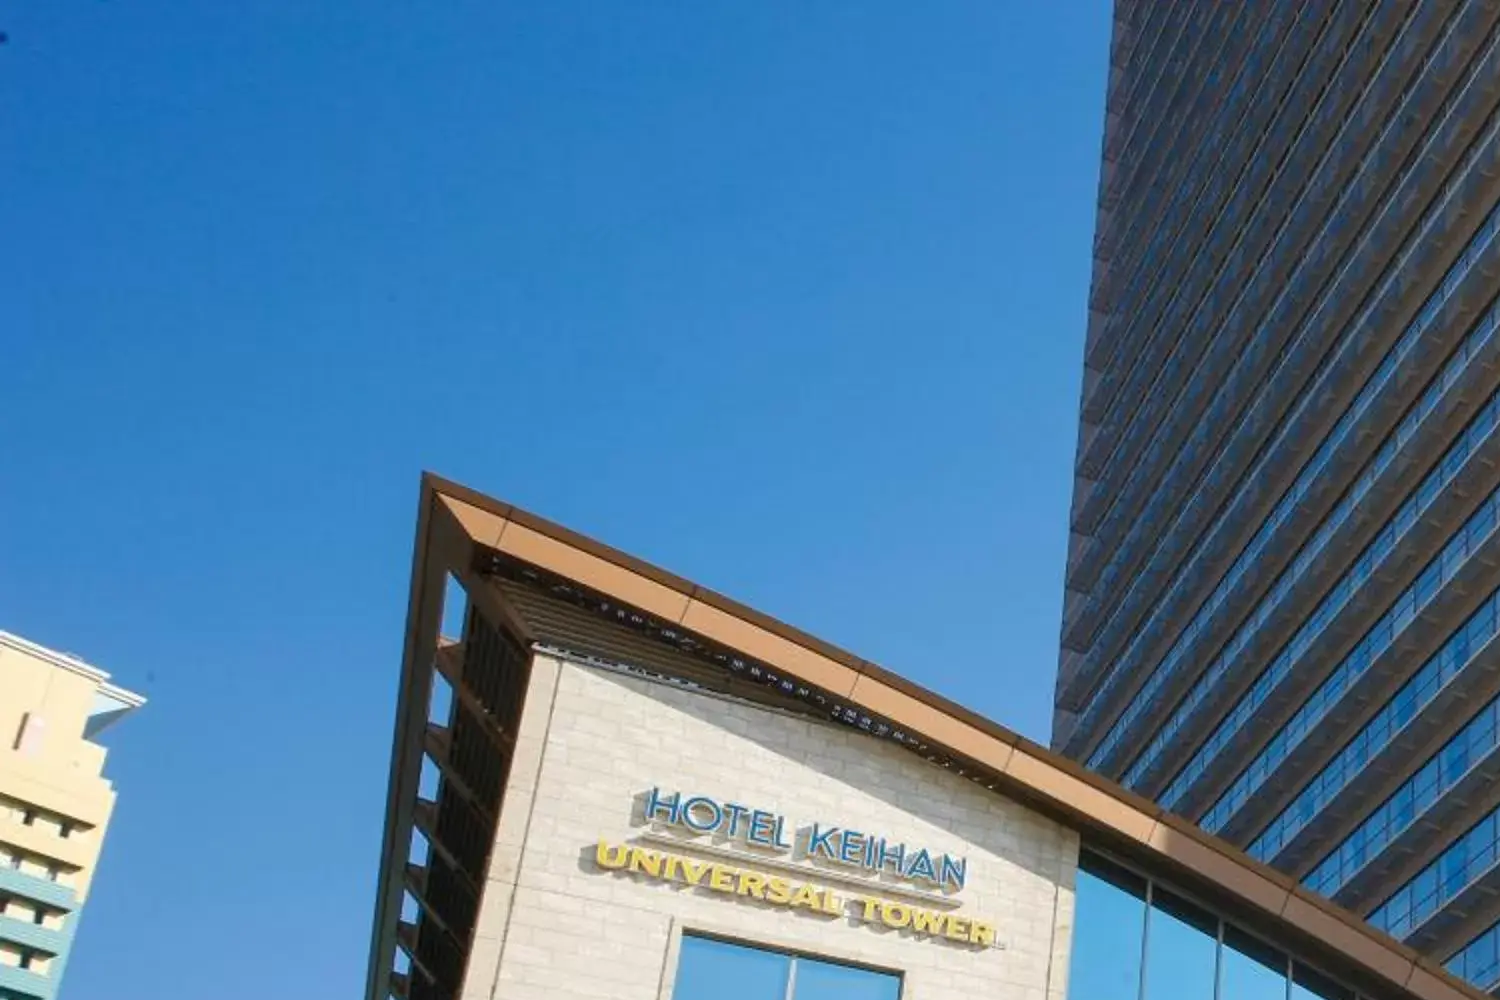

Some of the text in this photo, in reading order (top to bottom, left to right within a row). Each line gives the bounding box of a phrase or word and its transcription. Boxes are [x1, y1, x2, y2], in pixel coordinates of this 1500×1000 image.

[596, 837, 996, 947] UNIVERSAL TOWER
[646, 786, 967, 891] HOTEL KEIHAN
